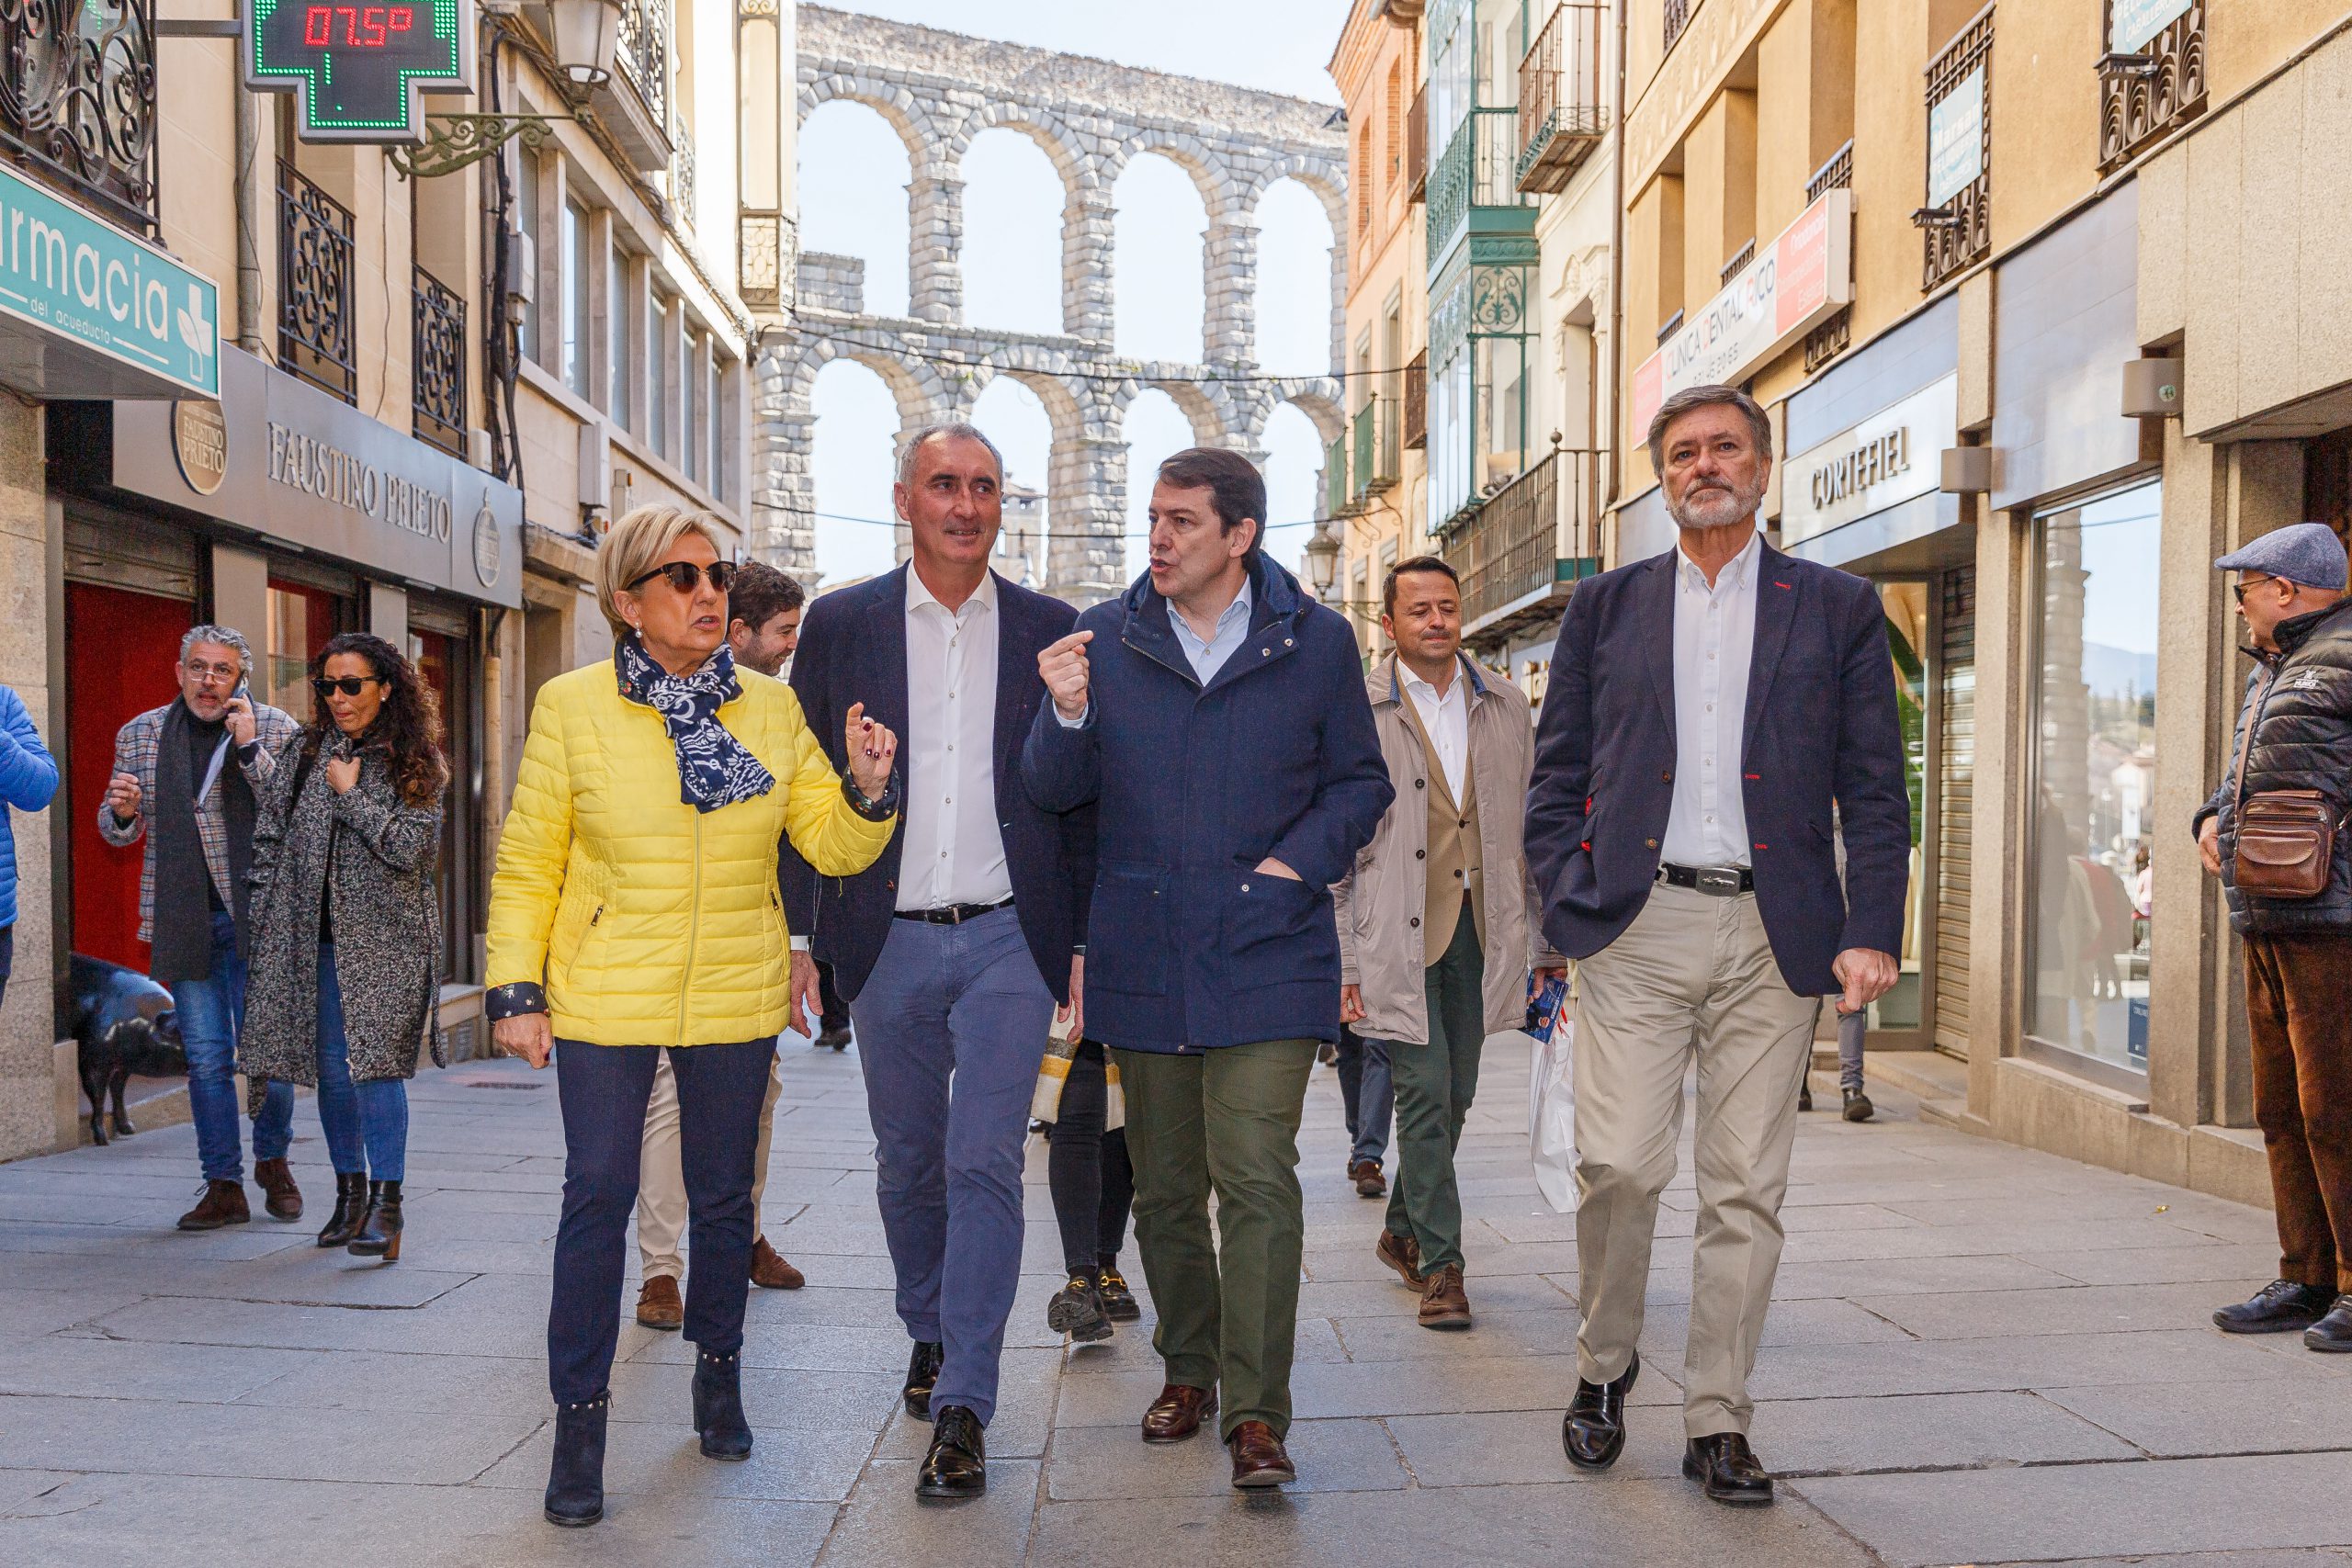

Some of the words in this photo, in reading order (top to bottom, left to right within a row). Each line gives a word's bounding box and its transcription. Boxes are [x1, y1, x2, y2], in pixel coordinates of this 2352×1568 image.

[0, 200, 169, 343] rmacia
[1702, 290, 1744, 351] DENTAL
[1746, 258, 1776, 308] RICO
[30, 298, 49, 318] del
[55, 310, 110, 344] acueducto
[182, 435, 225, 474] PRIETO
[183, 415, 224, 449] FAUSTINO
[1810, 426, 1911, 511] CORTEFIEL
[267, 422, 379, 517] FAUSTINO
[383, 472, 452, 545] PRIETO
